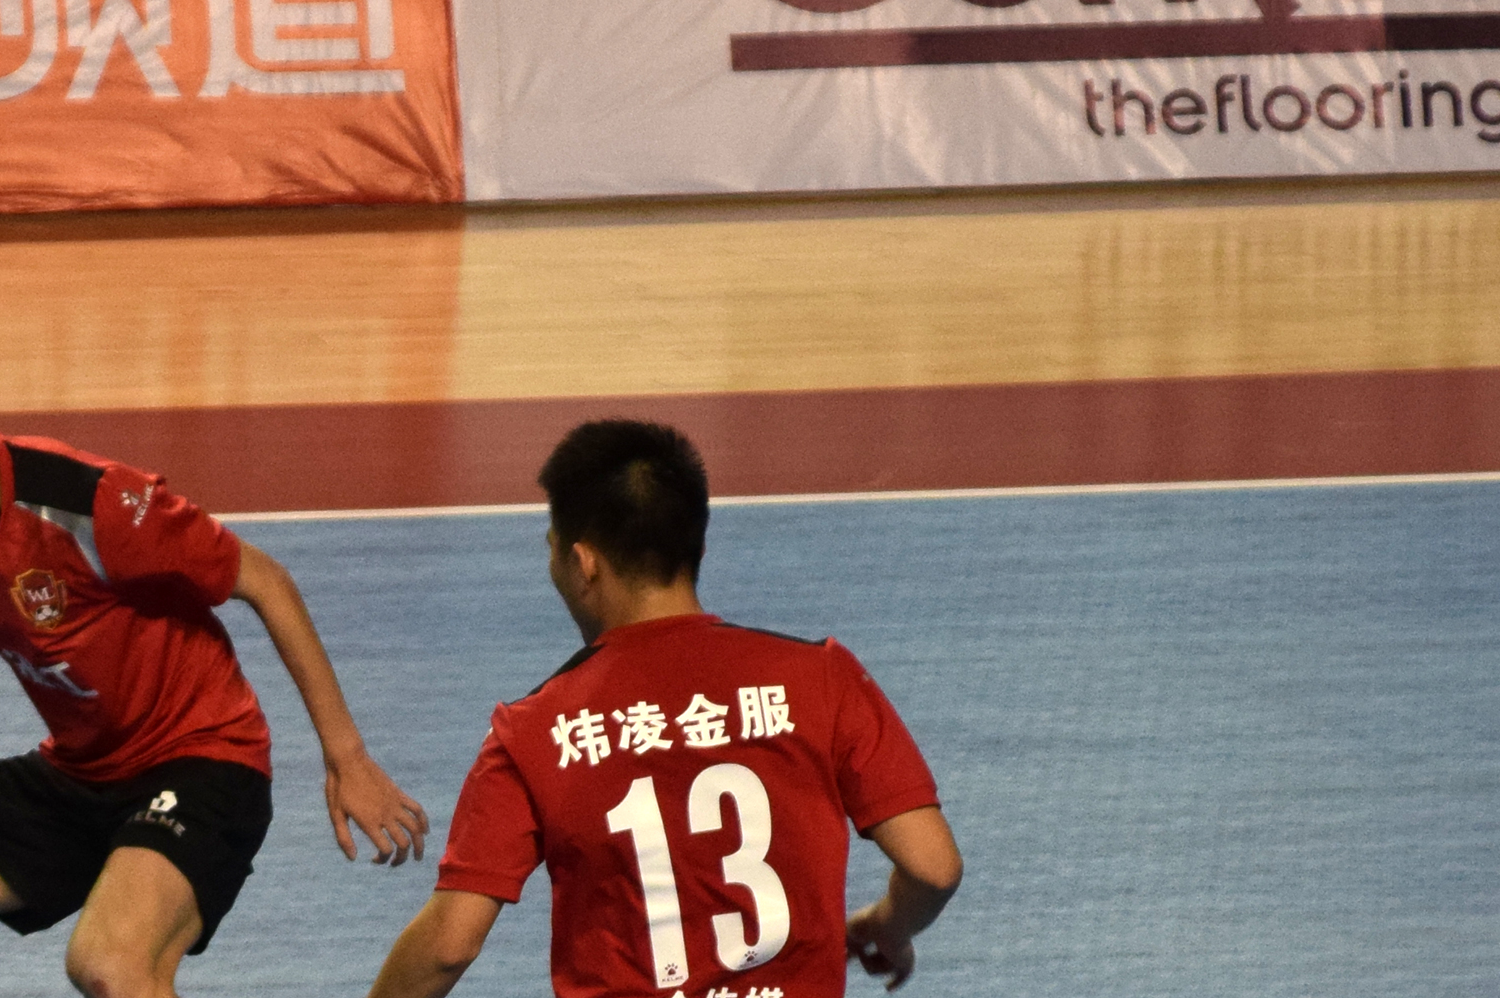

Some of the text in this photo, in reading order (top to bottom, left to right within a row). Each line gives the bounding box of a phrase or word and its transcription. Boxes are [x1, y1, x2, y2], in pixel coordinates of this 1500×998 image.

[1084, 67, 1500, 143] theflooring
[550, 684, 796, 769] 炜凌金服
[605, 762, 791, 990] 13
